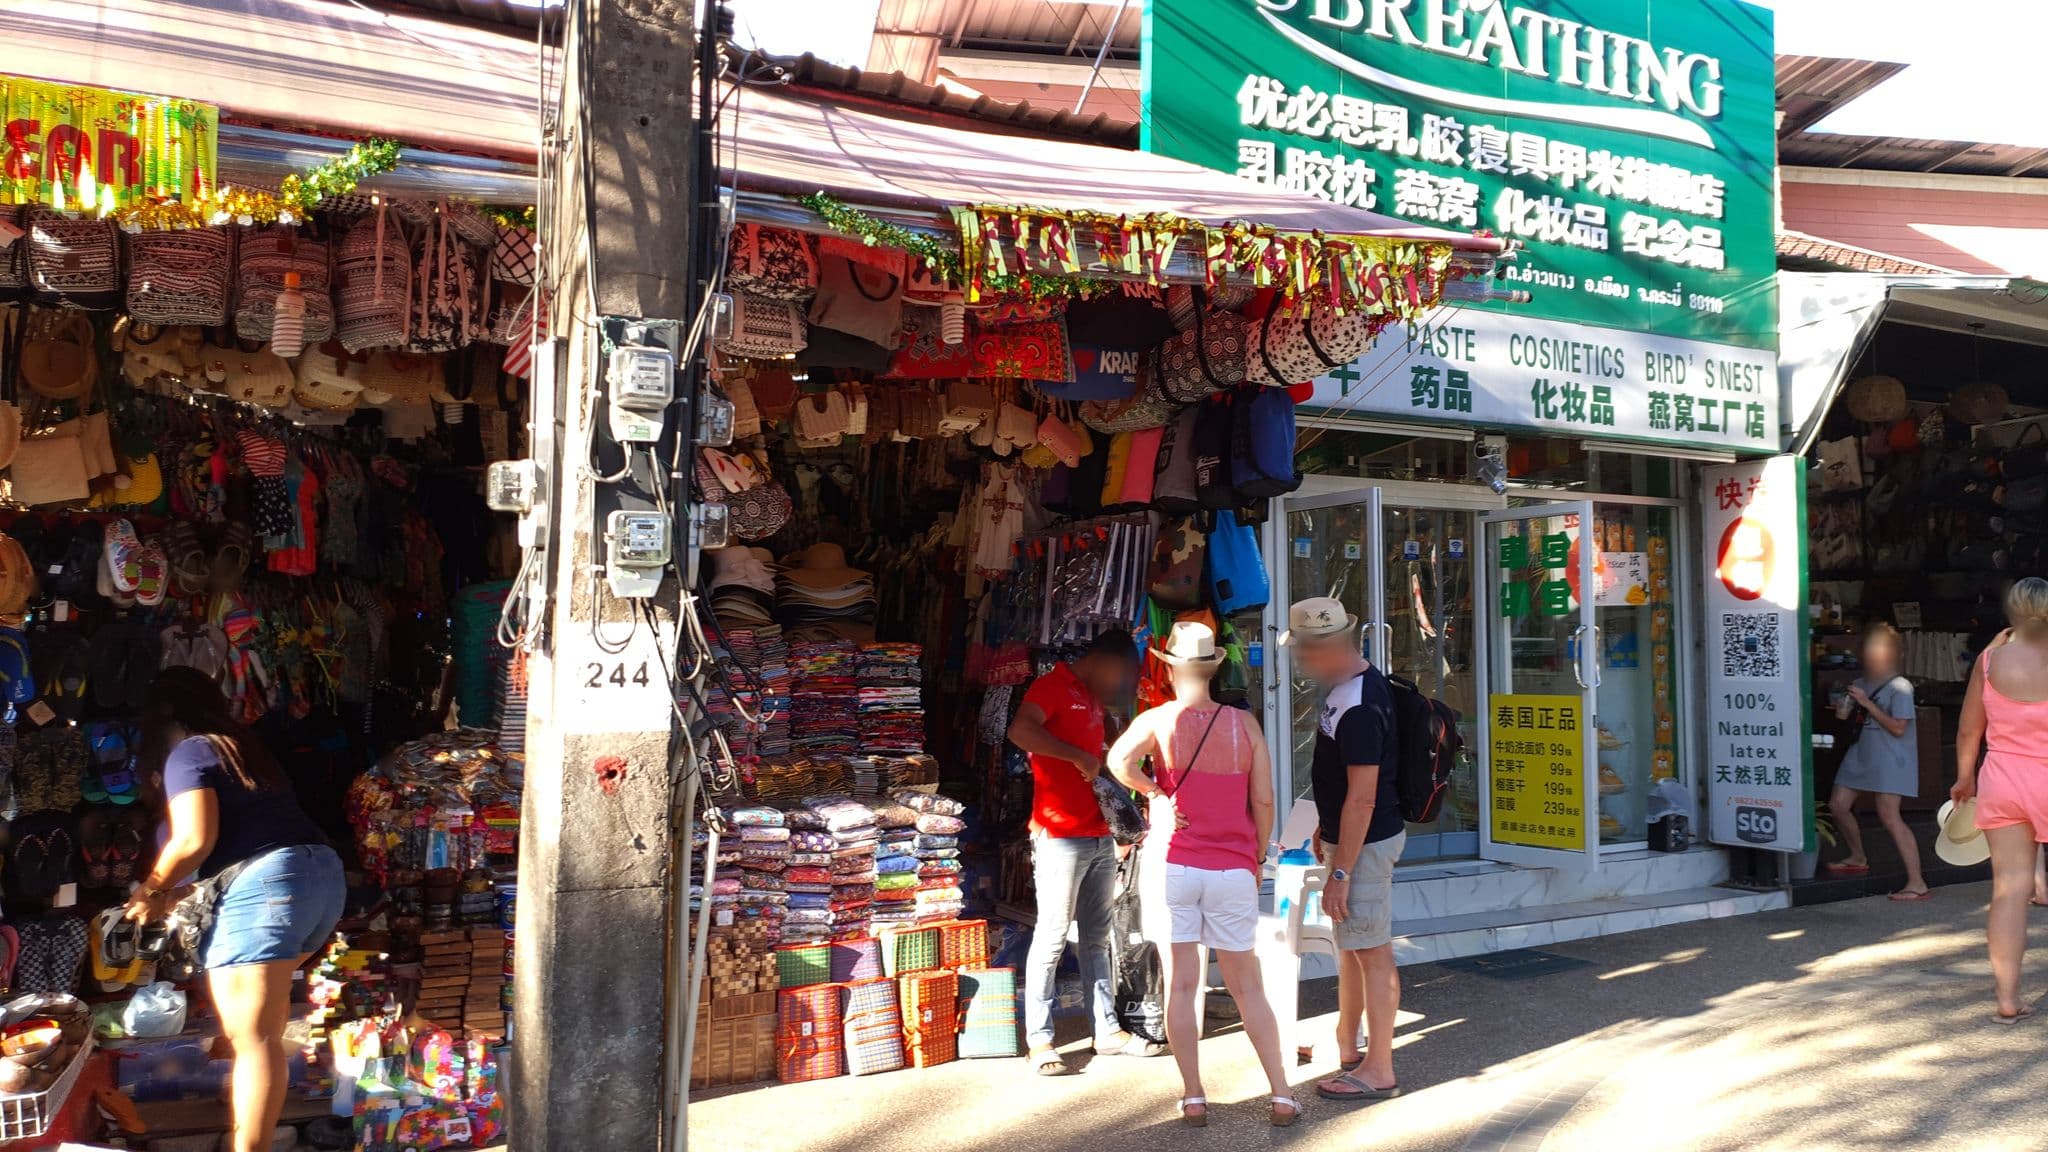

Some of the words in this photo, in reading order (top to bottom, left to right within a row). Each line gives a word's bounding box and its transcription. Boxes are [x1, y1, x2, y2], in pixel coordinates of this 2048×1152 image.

[1255, 0, 1723, 118] REATHING
[1237, 139, 1376, 210] 乳胶枕
[1393, 168, 1481, 227] 燕窝
[1494, 187, 1609, 250] 化妆品
[1621, 211, 1725, 271] 纪念品
[1407, 322, 1476, 362] PASTE
[1509, 332, 1625, 380] COSMETICS
[1719, 358, 1764, 395] NEST
[1411, 364, 1473, 413] 药品
[1530, 378, 1616, 427] 化妆品
[1648, 390, 1767, 439] 燕窝工厂店
[585, 661, 650, 687] 244
[1723, 693, 1775, 712] 100%
[1497, 705, 1576, 731] 泰国正品
[1718, 721, 1784, 737] Natural
[1730, 743, 1777, 759] latex
[1715, 764, 1793, 787] 天然乳胶
[1737, 810, 1776, 834] sto
